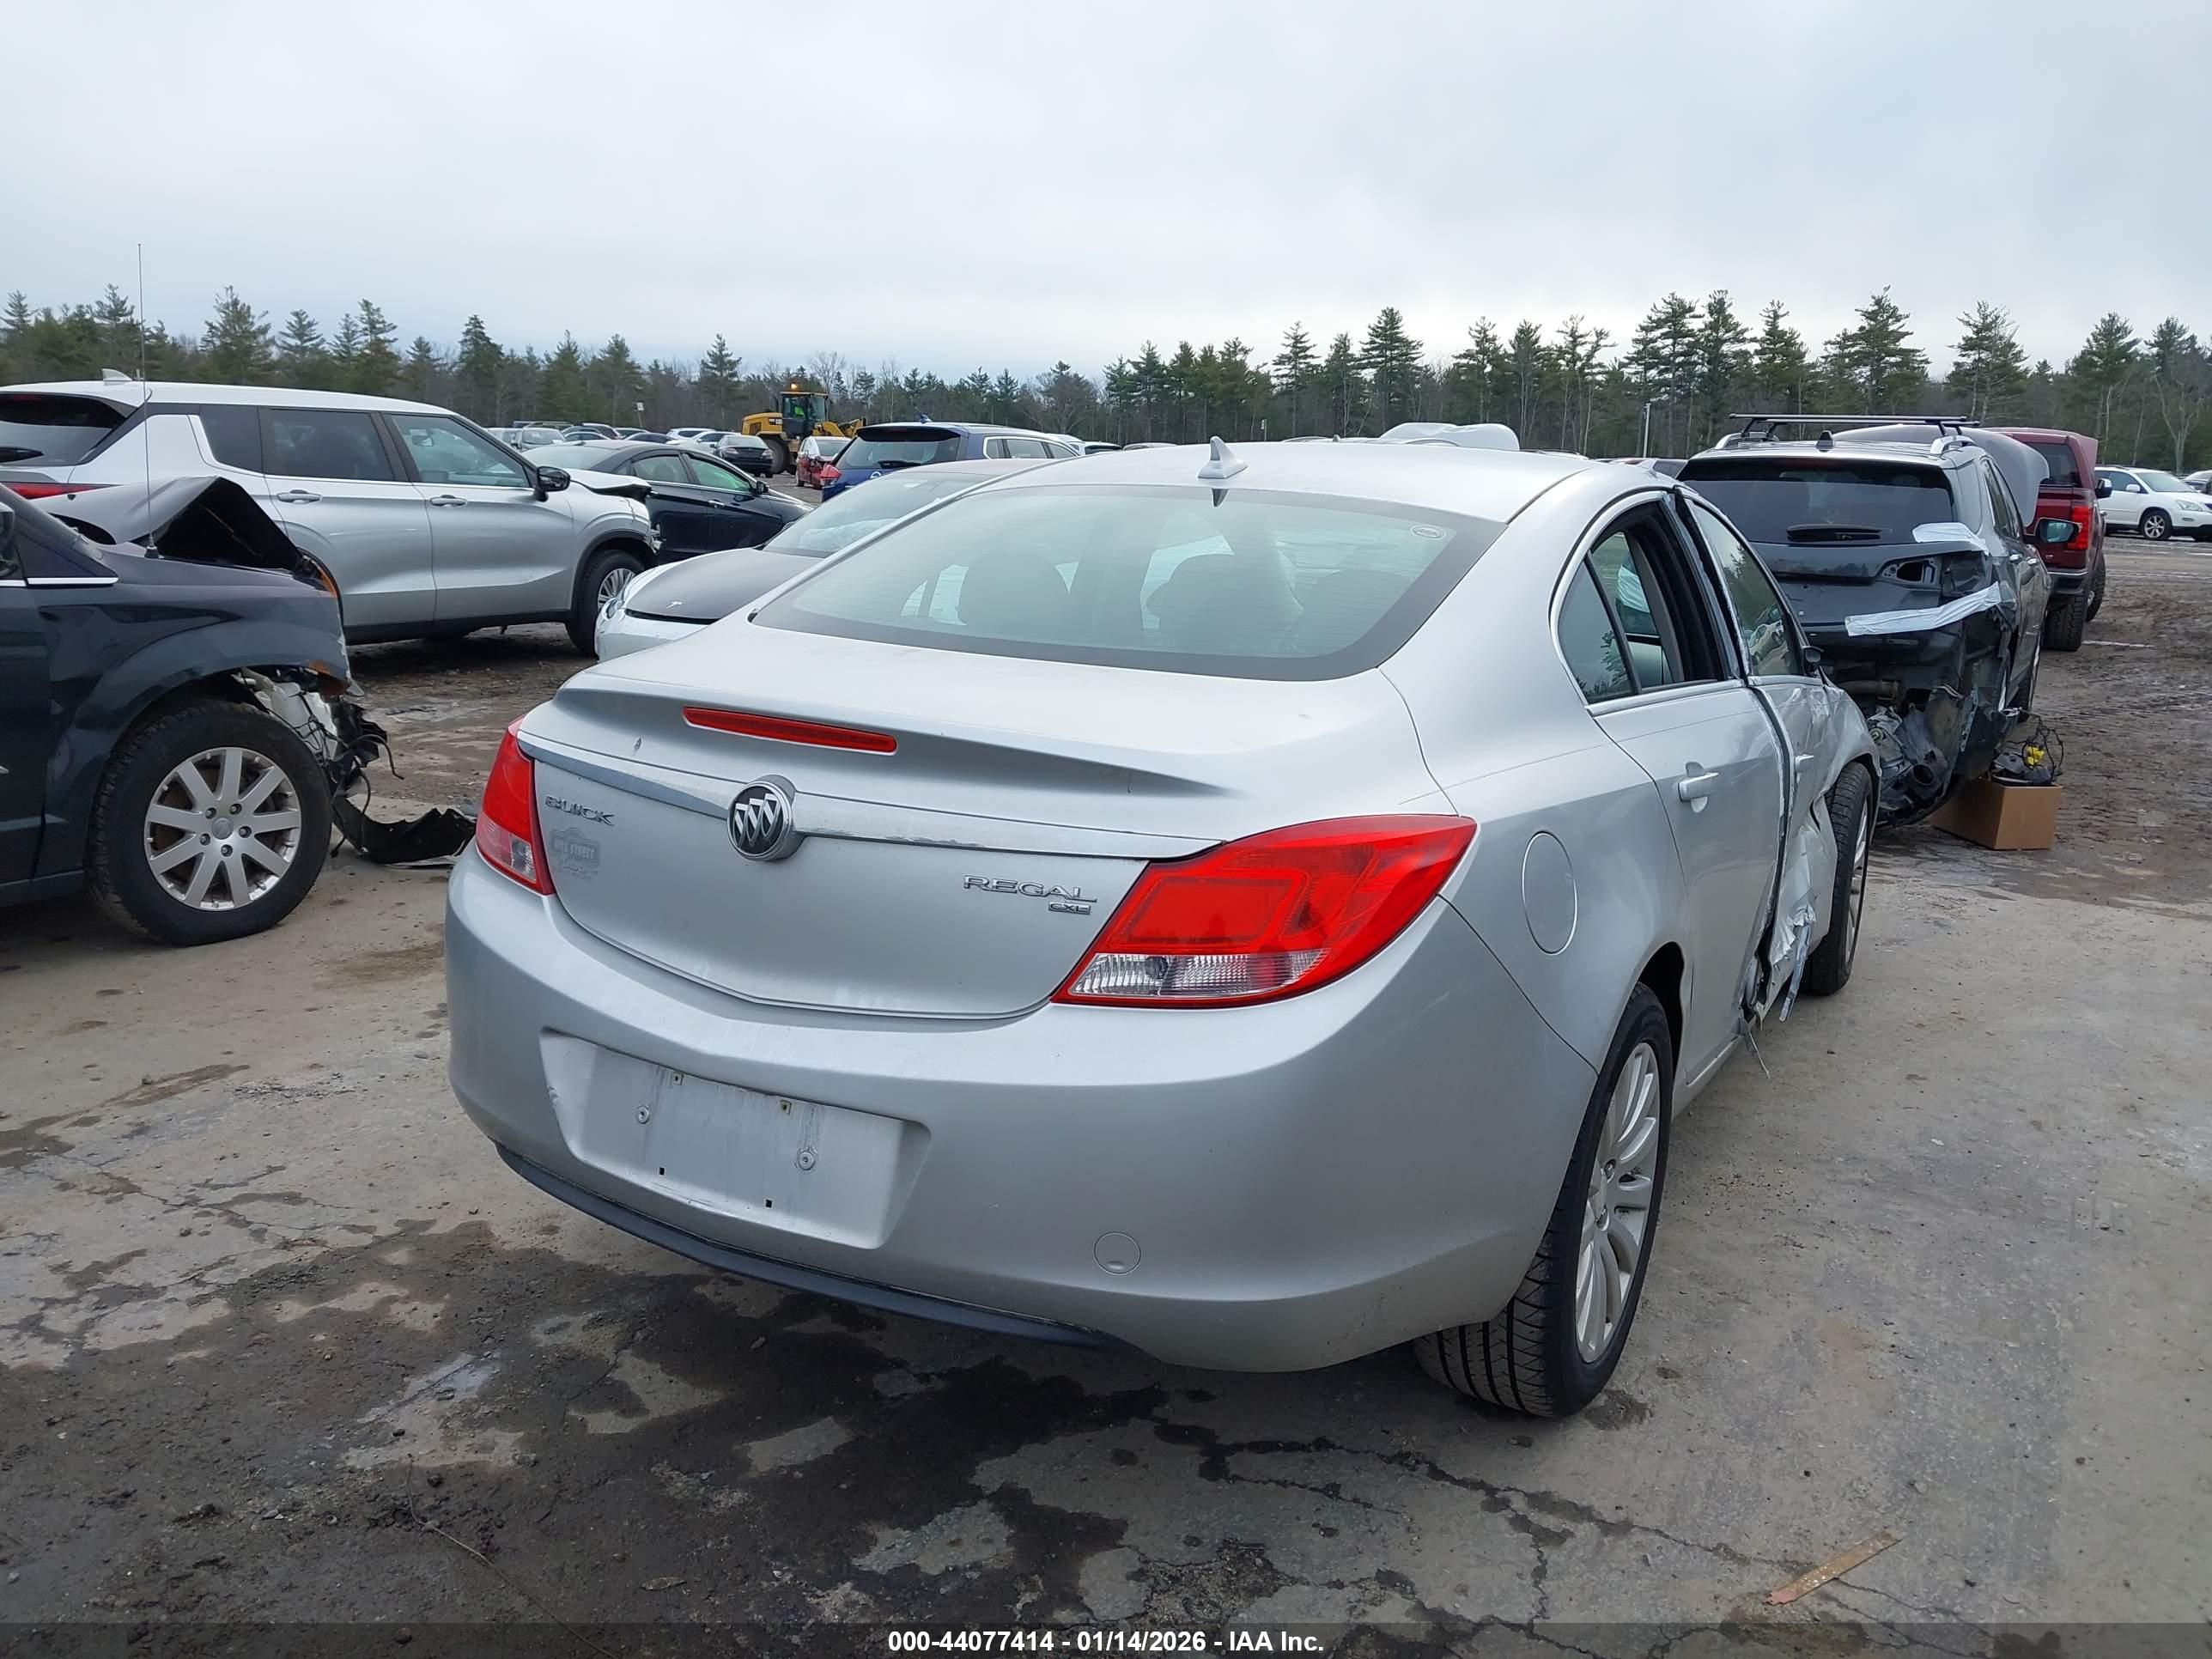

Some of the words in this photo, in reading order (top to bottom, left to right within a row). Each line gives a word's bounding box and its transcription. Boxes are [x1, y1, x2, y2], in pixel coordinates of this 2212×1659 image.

[545, 795, 615, 826] BUICK
[963, 874, 1098, 903] REGAL
[1048, 902, 1091, 915] CXL
